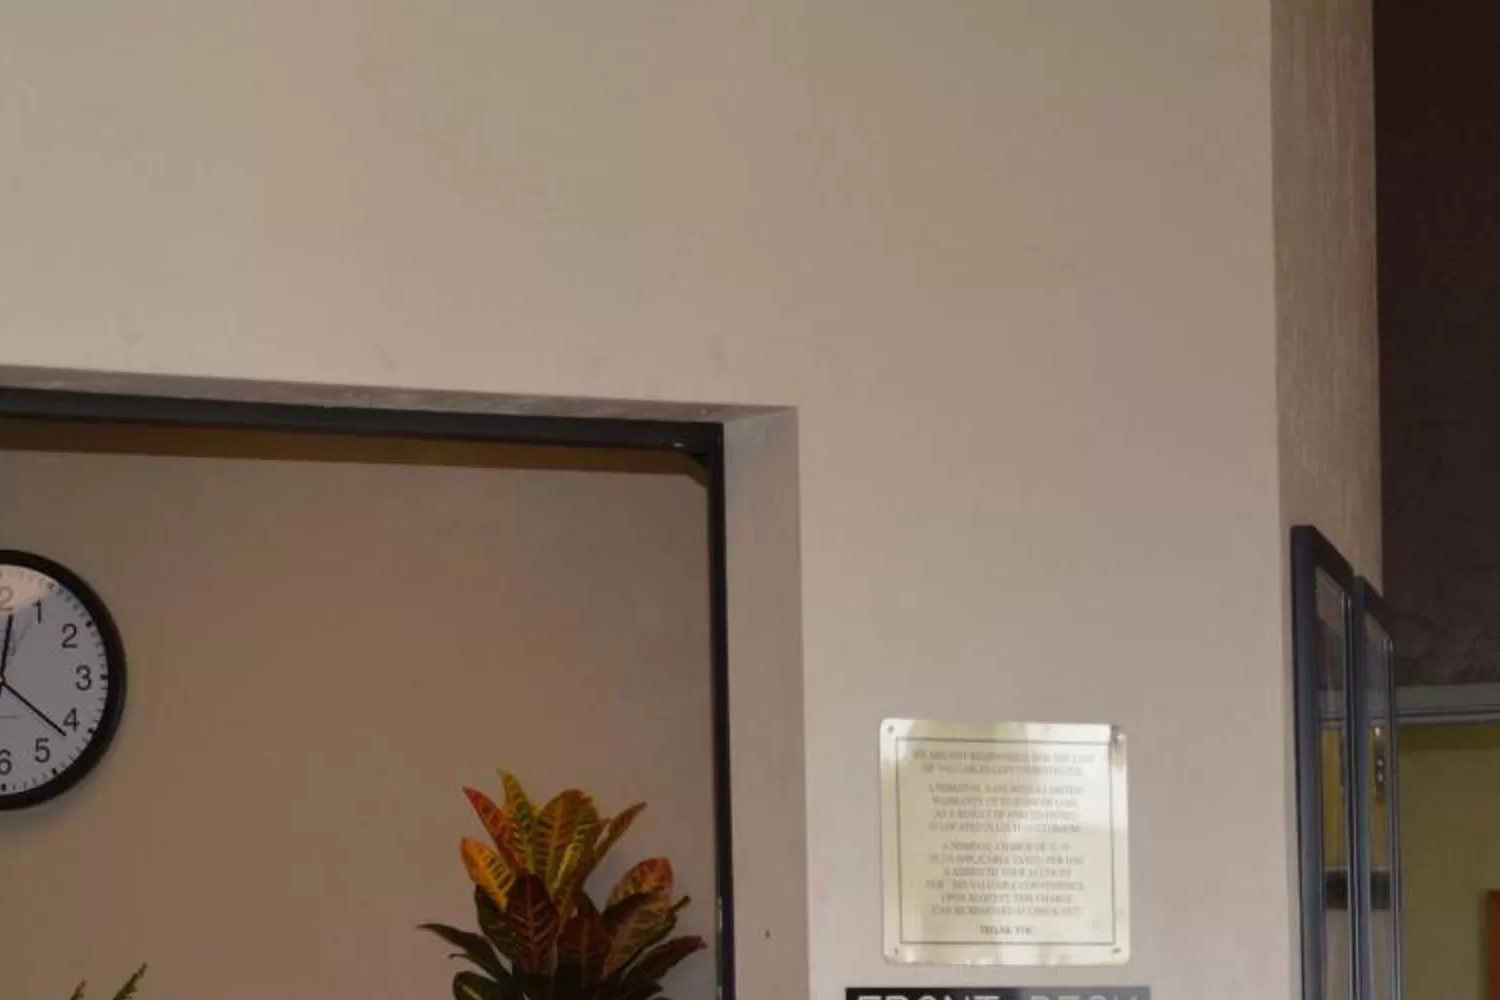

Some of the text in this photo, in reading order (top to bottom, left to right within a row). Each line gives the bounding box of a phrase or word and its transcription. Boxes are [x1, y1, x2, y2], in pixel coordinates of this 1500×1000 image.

[32, 600, 43, 624] 1
[61, 623, 78, 649] 2
[75, 665, 92, 691] 3
[63, 707, 80, 732] 4
[34, 738, 51, 763] 5
